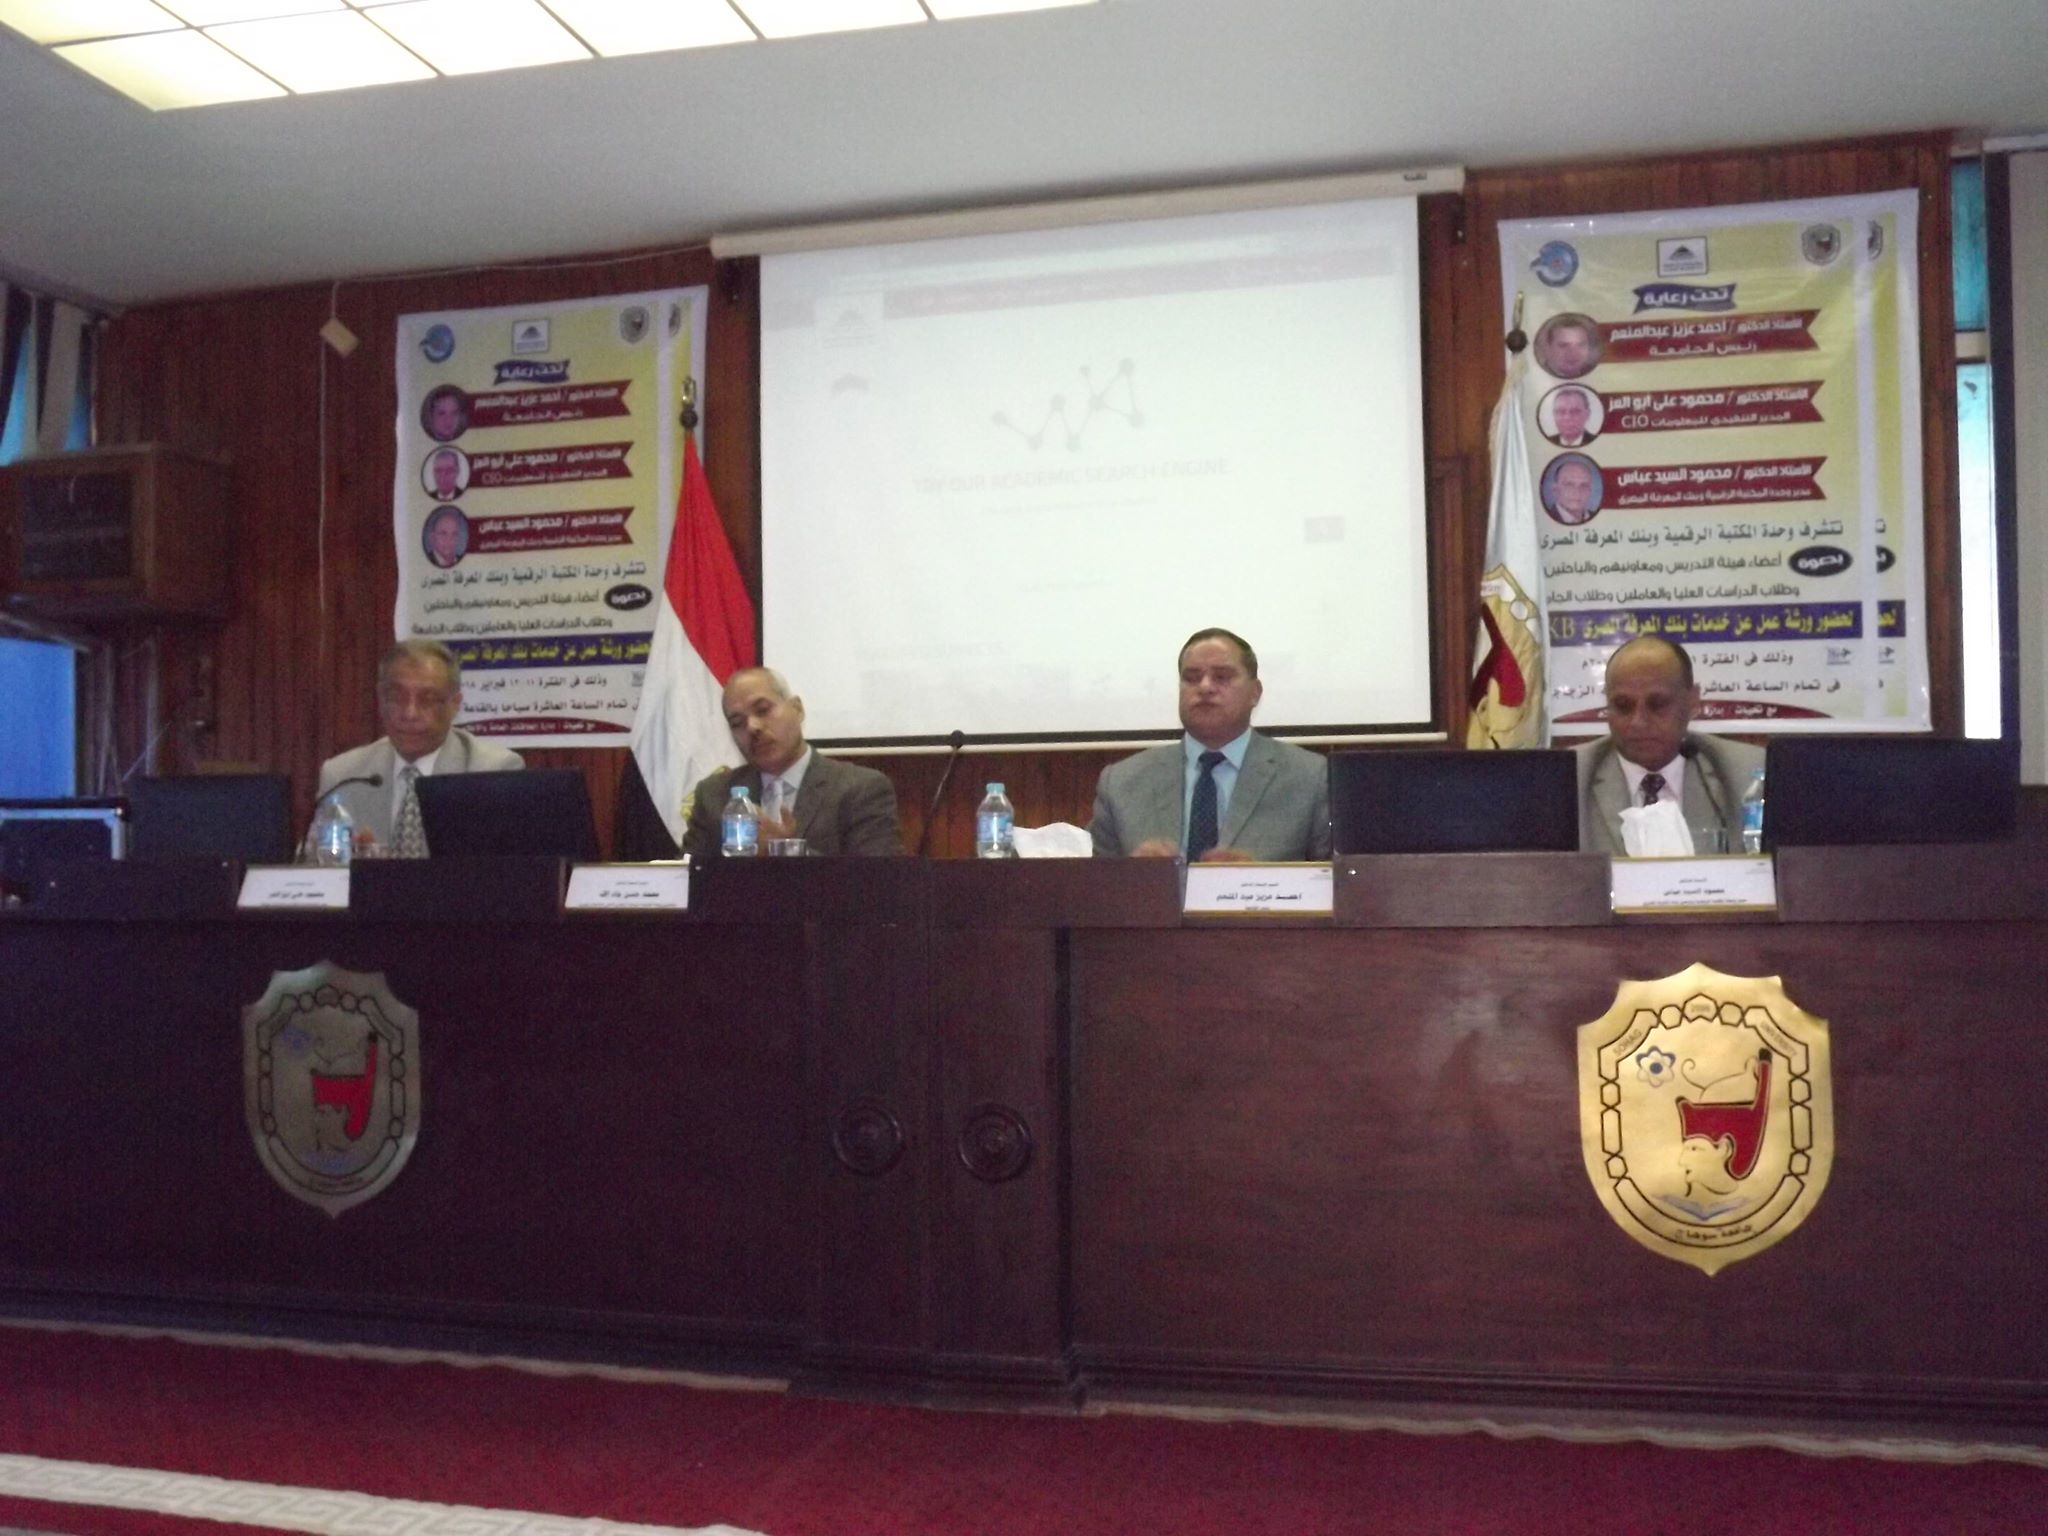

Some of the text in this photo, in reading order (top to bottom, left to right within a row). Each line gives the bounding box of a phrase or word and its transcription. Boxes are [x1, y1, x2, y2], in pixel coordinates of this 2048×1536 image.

[1644, 287, 1728, 304] تحت رعاية
[1679, 394, 1724, 408] محمود
[1621, 414, 1649, 429] CIO
[1618, 470, 1653, 486] عباس
[1654, 468, 1687, 484] السيد
[1689, 468, 1732, 483] محمود
[1585, 528, 1623, 547] المعرفة
[1628, 529, 1659, 548] وبنك
[1664, 525, 1712, 546] الرقمية
[1718, 522, 1757, 543] المكتبة
[1762, 522, 1793, 541] وحدة
[1543, 560, 1597, 578] والباحثين
[1600, 560, 1663, 575] ومعاونيهم
[1665, 556, 1715, 574] التدريس
[1575, 587, 1613, 602] وطلاب
[1616, 587, 1671, 604] والعاملين
[1674, 585, 1703, 600] العليا
[1706, 584, 1758, 599] الدراسات
[1760, 582, 1800, 598] وطلاب
[1701, 652, 1740, 667] الفترة
[1763, 649, 1793, 665] وذلك
[1696, 681, 1740, 696] العاشر
[1746, 679, 1789, 693] الساعة
[1794, 679, 1821, 693] تمام
